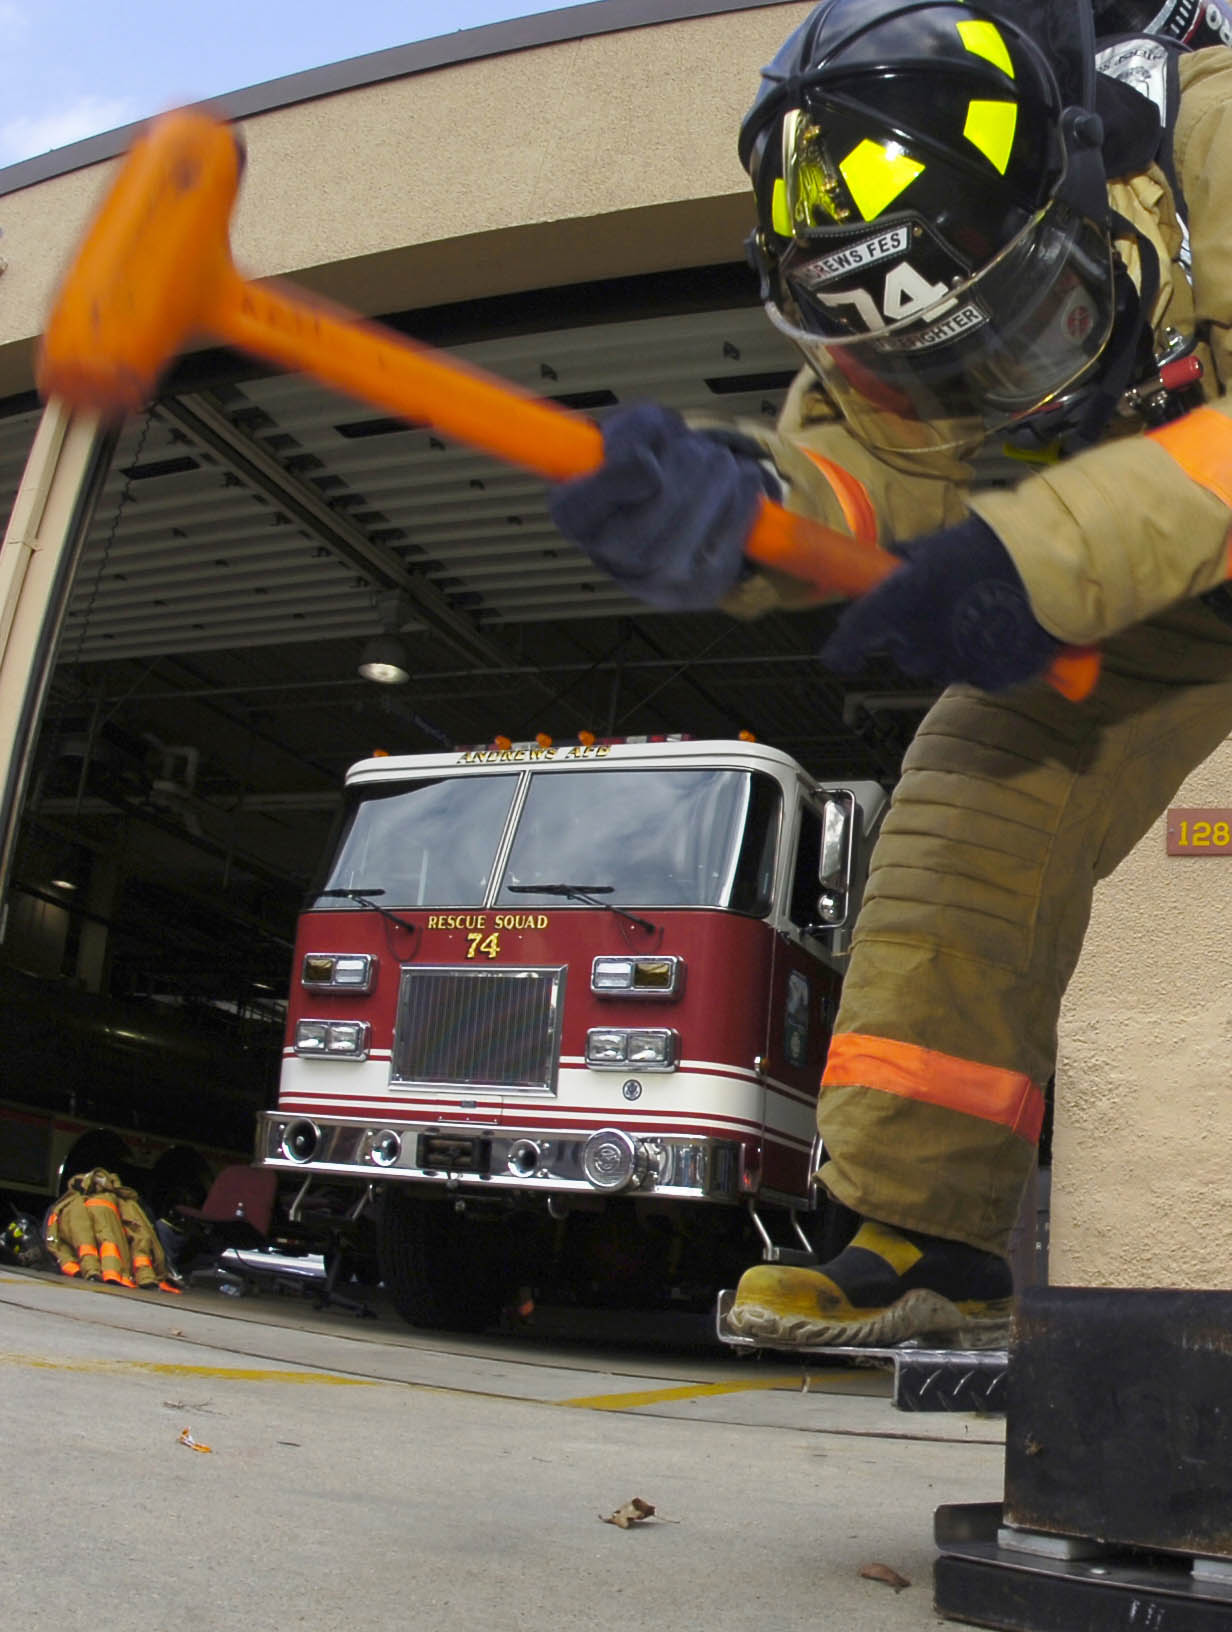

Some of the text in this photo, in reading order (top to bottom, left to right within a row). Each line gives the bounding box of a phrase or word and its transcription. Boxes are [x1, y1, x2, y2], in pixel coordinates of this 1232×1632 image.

[868, 231, 901, 258] FES
[816, 261, 958, 337] 74
[456, 748, 559, 764] ANDREWS
[427, 915, 549, 930] RESCUE SQUAD
[466, 932, 500, 958] 74
